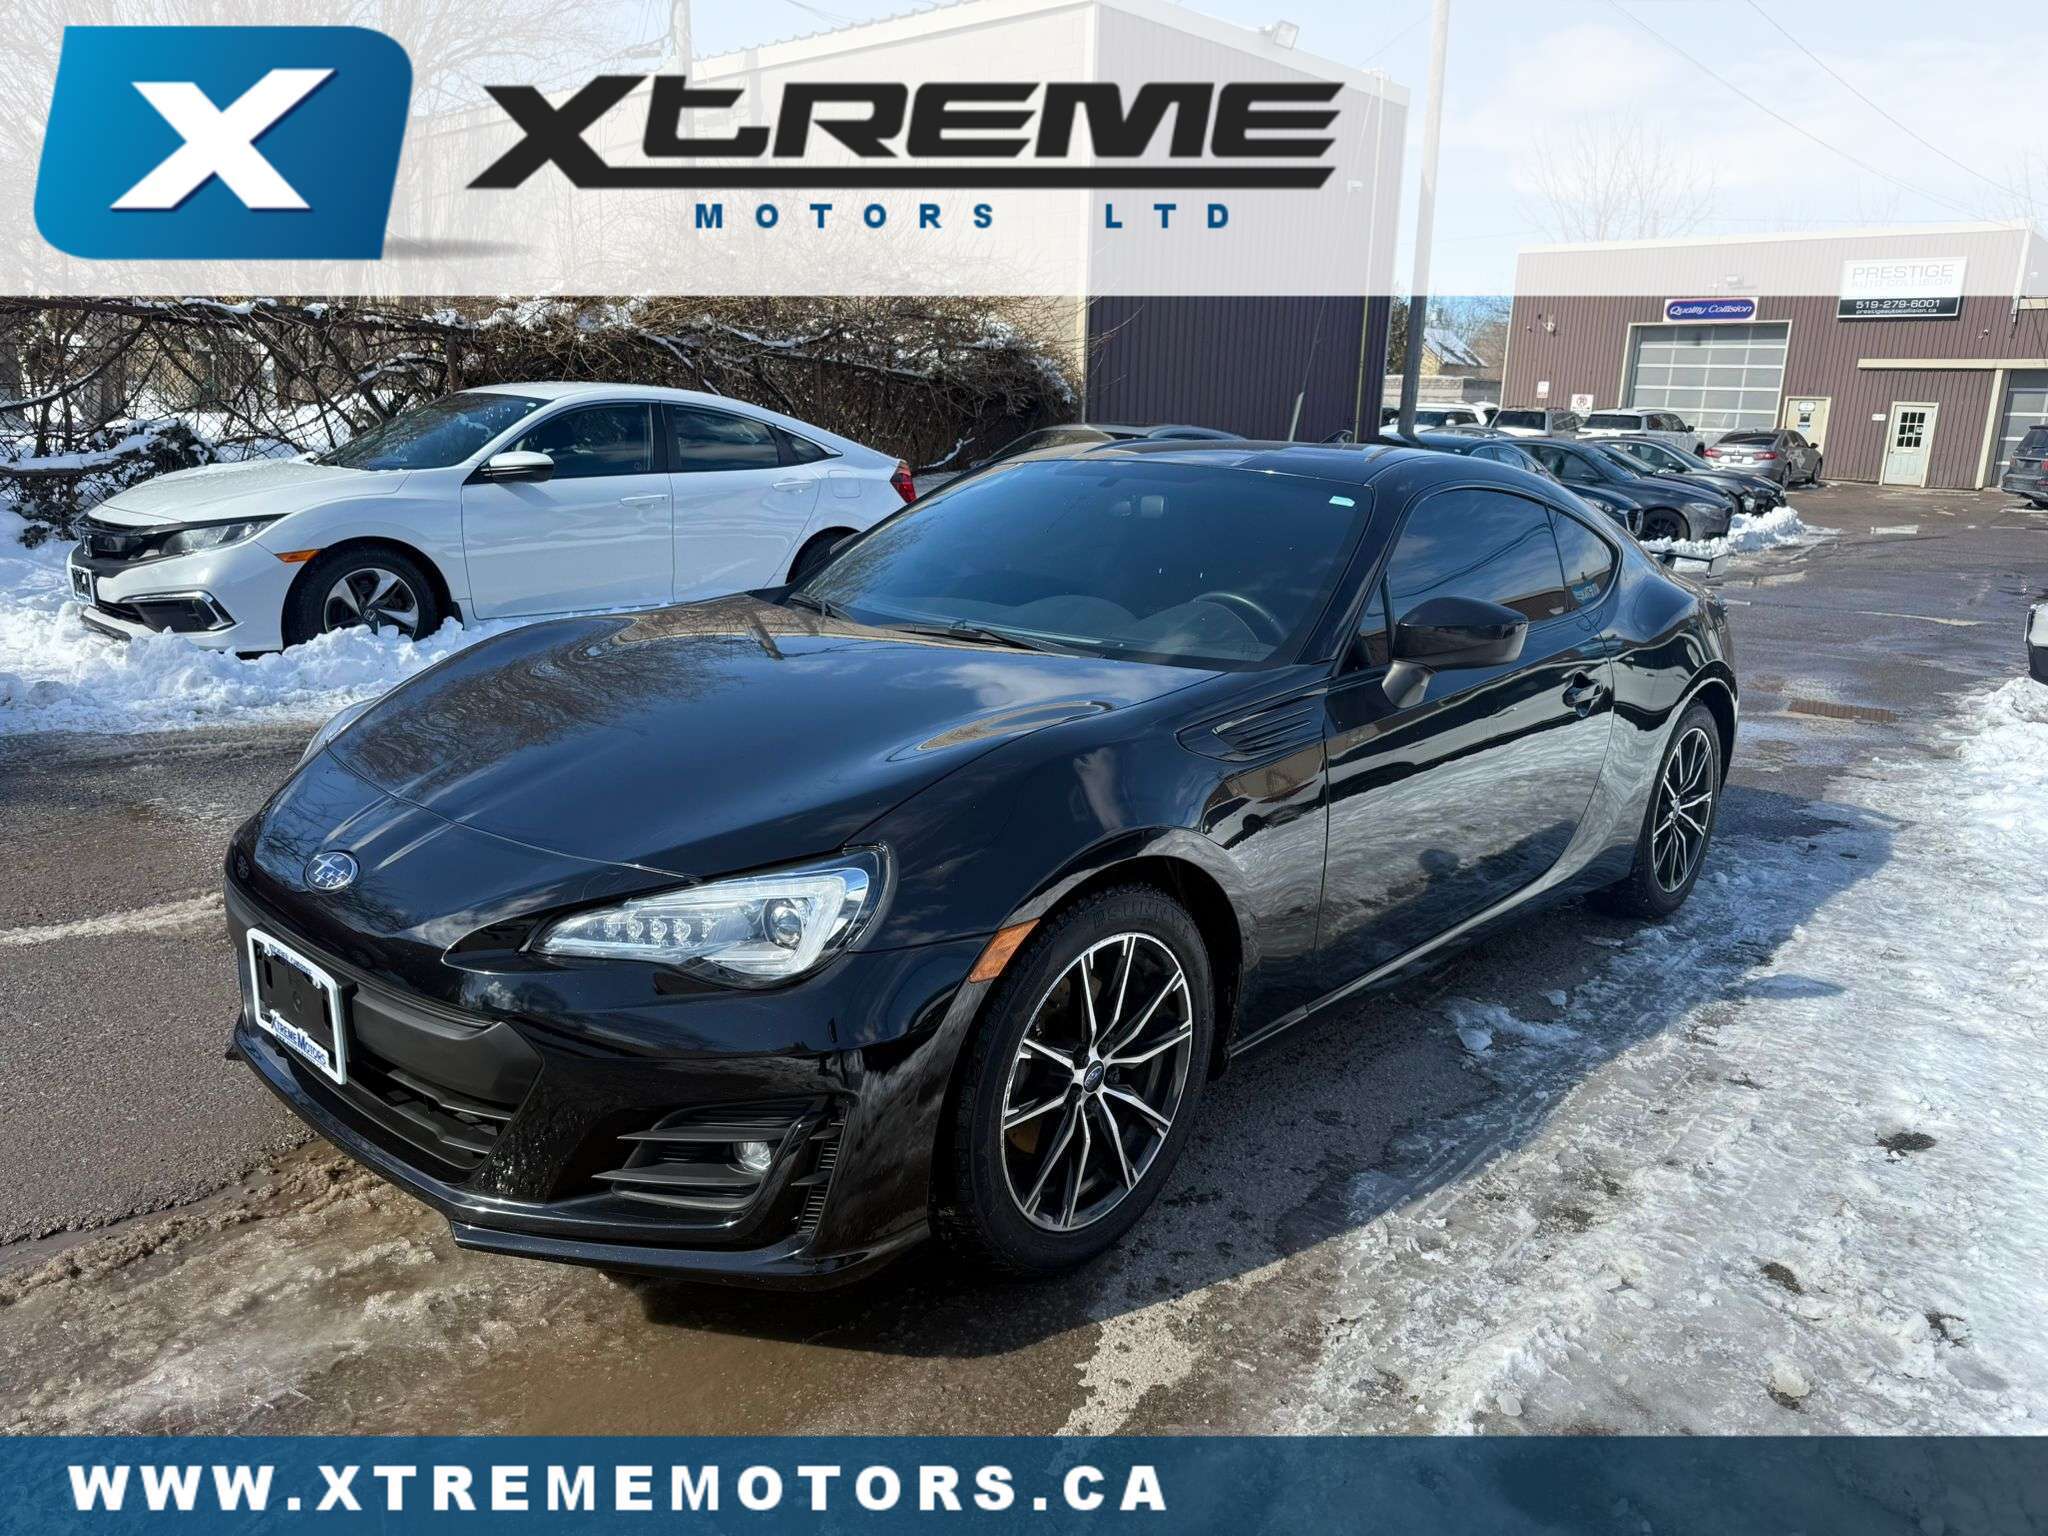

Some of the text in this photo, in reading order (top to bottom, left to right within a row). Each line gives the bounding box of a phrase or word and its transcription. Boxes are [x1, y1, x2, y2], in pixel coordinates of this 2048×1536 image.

[1852, 264, 1954, 280] PRESTIGE
[1669, 304, 1753, 315] Quality Collision
[1855, 299, 1941, 309] 519-279-6001
